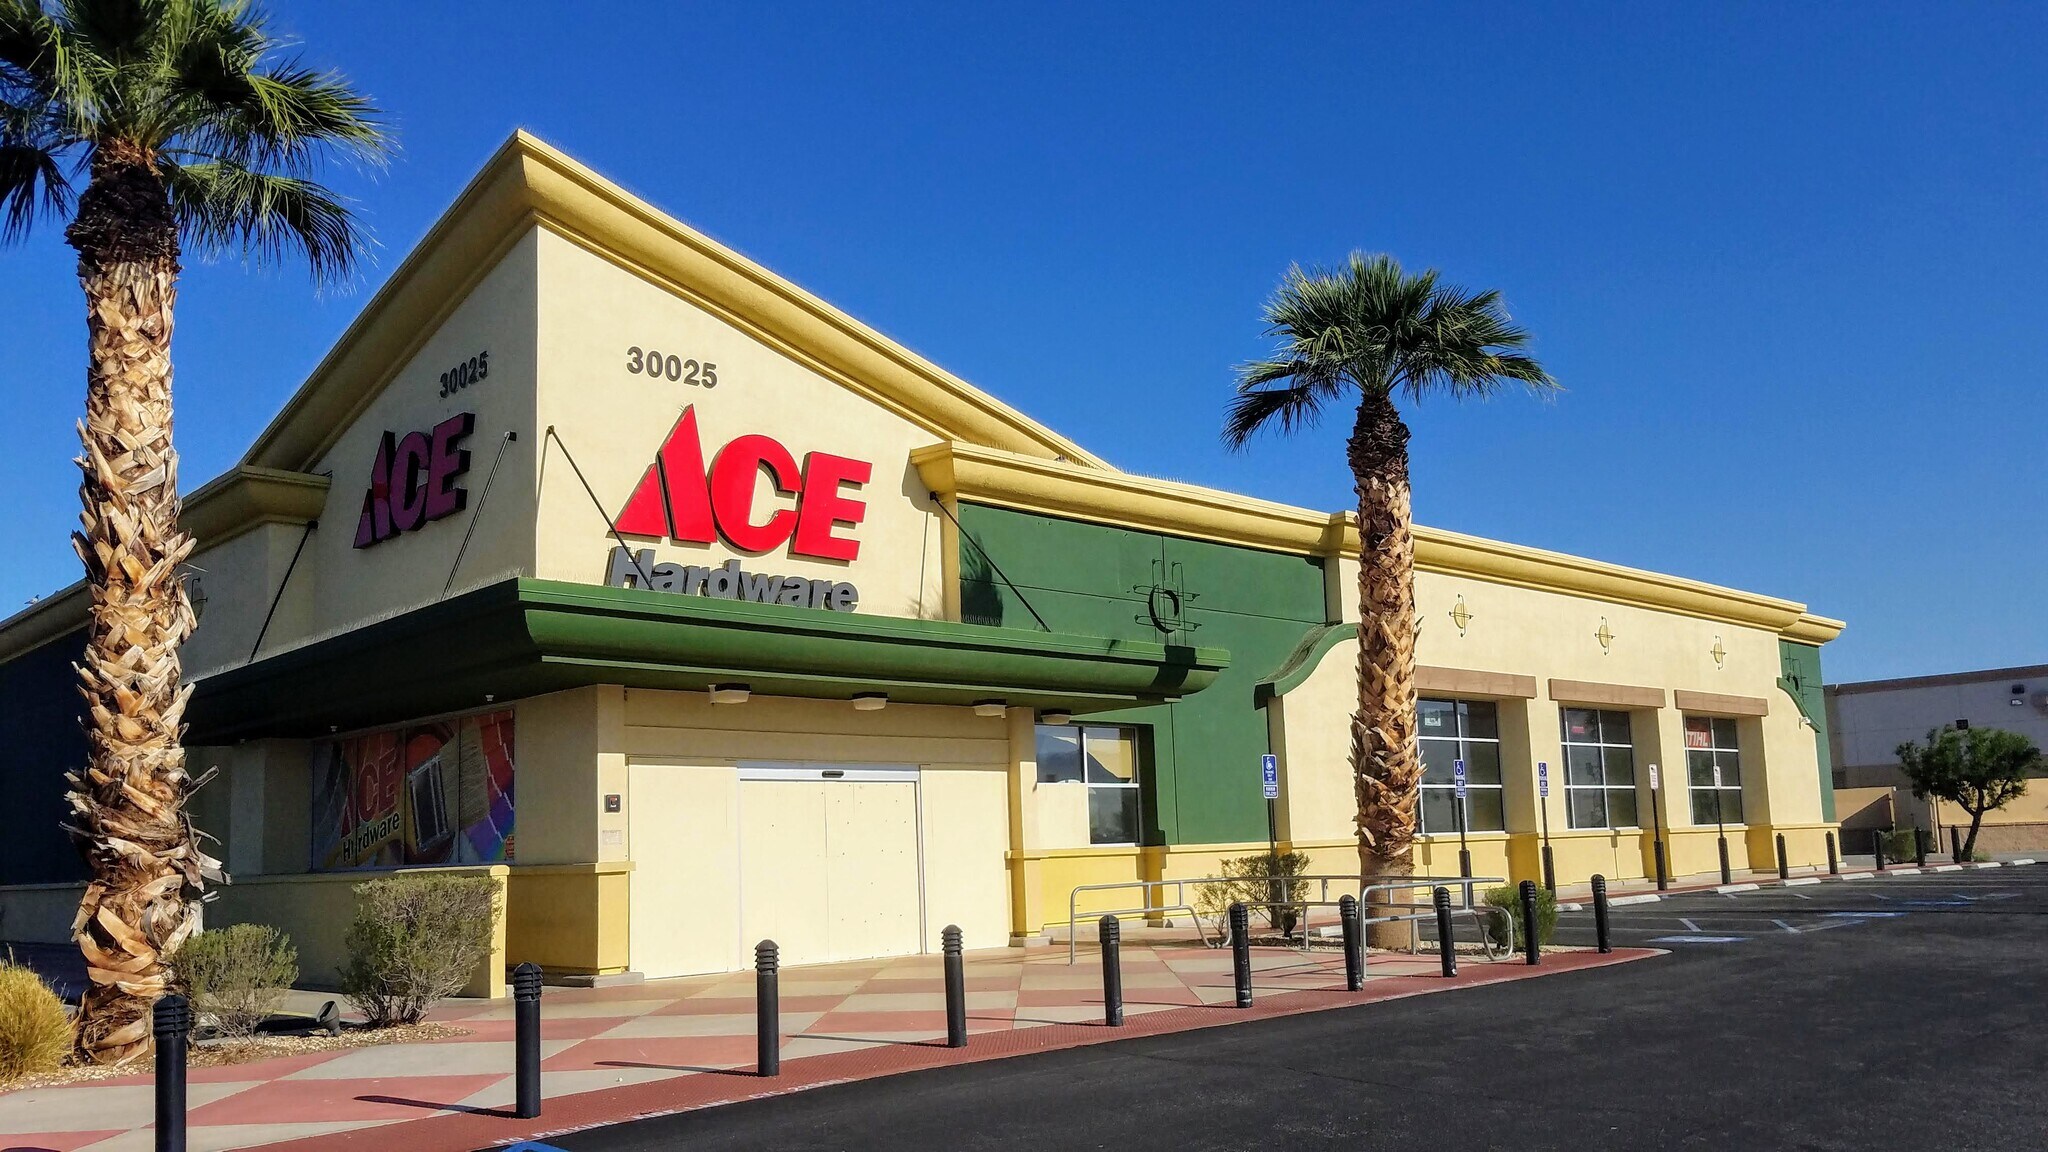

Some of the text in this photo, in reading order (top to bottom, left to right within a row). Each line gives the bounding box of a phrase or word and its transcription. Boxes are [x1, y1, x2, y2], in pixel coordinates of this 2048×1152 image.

[439, 350, 489, 398] 30025
[626, 346, 718, 389] 30025
[353, 412, 475, 549] ACE
[607, 403, 873, 562] ACE
[603, 545, 860, 613] Hardware
[1687, 731, 1709, 747] TIHL
[531, 1120, 619, 1139] PARKING
